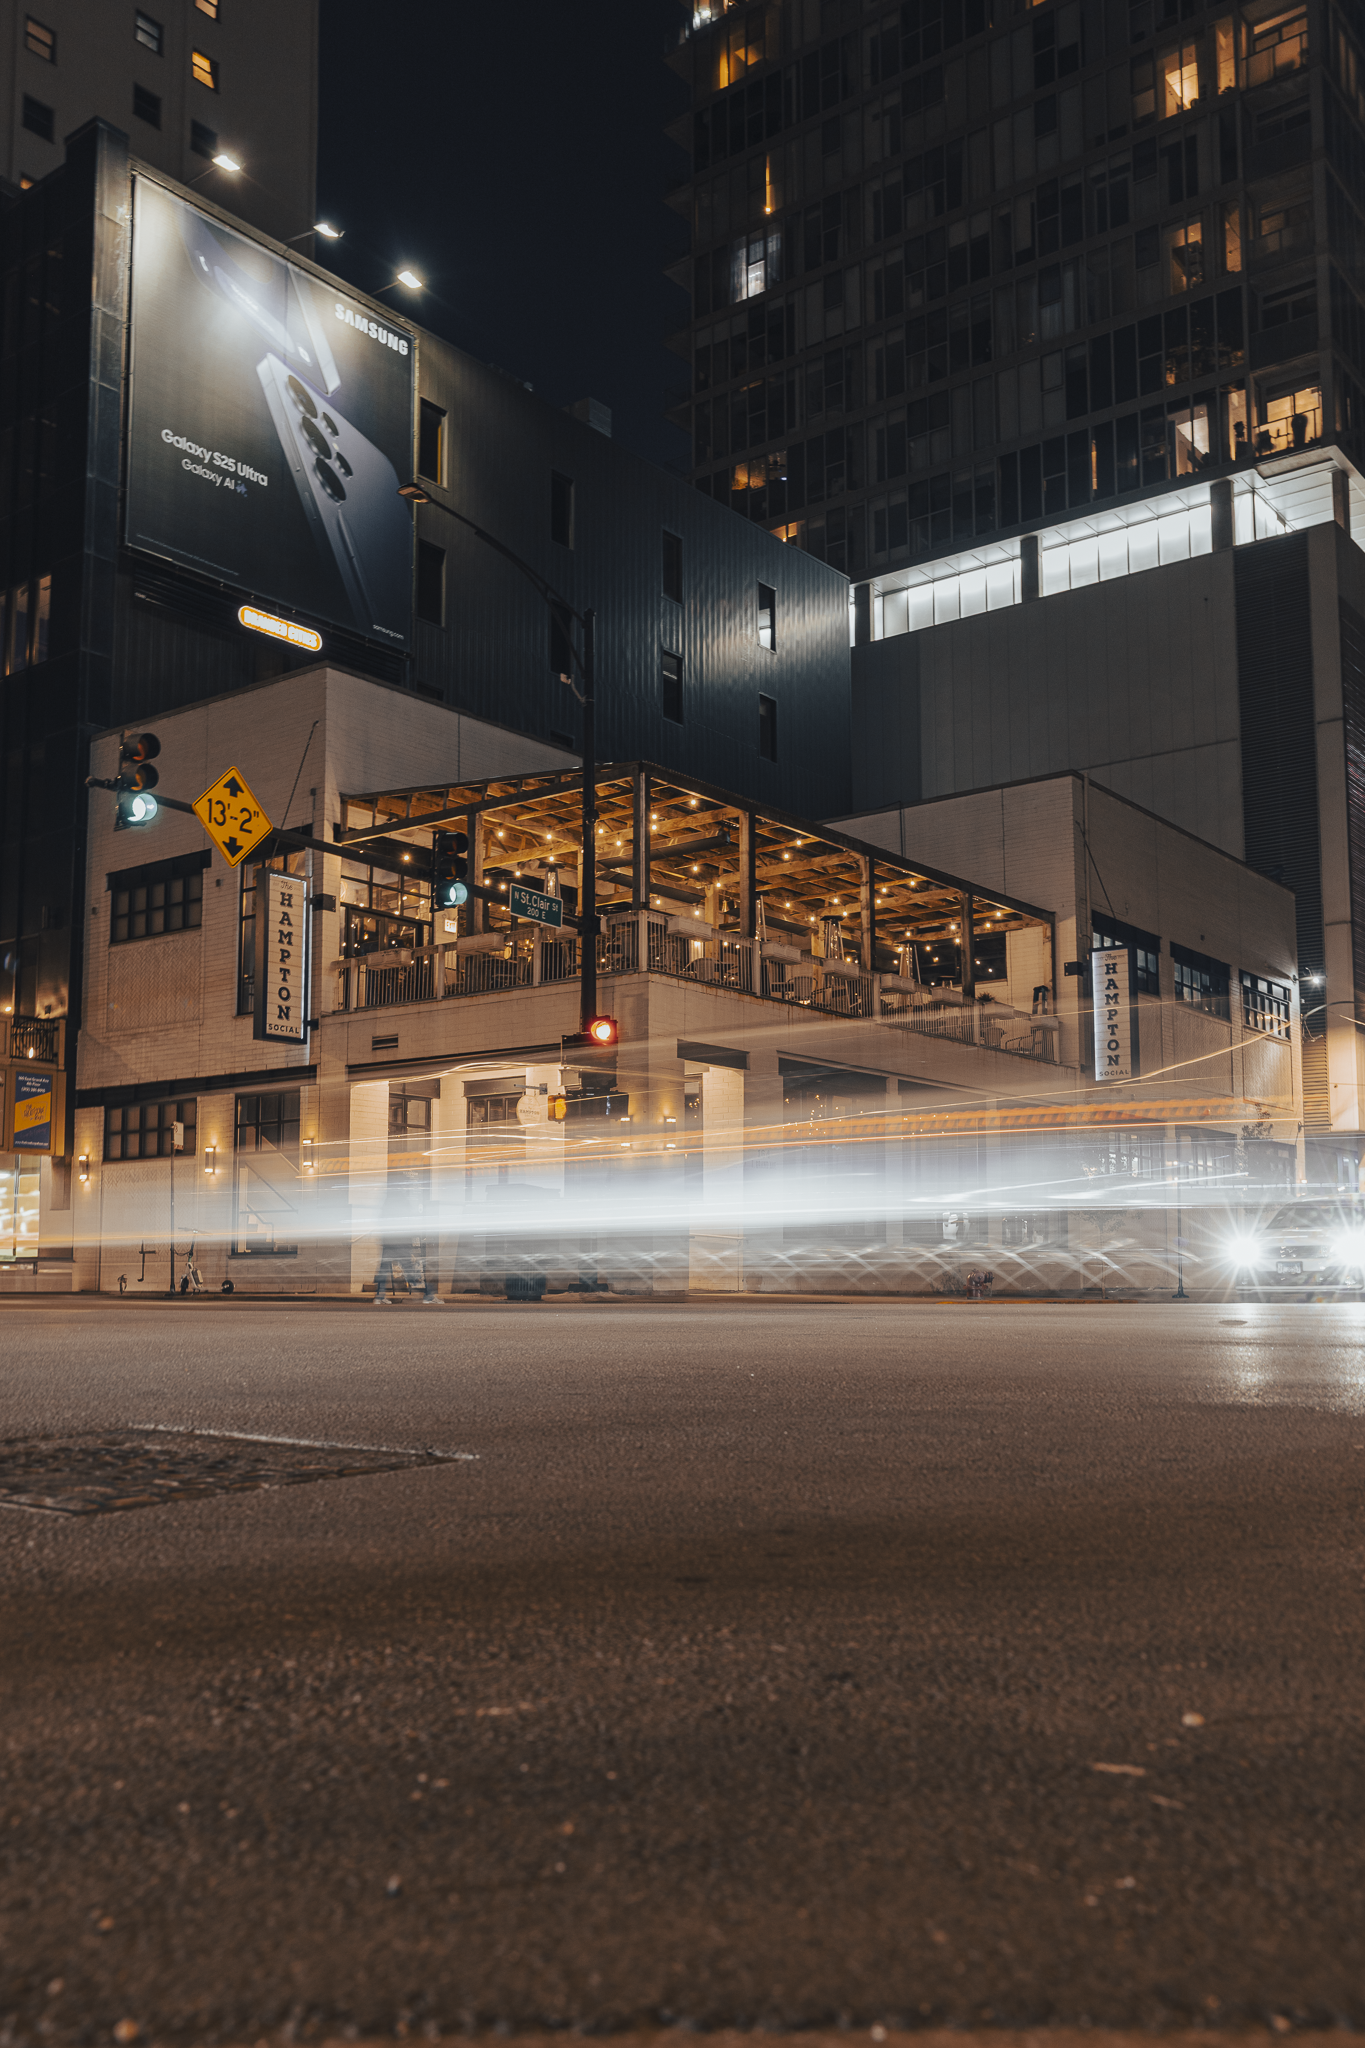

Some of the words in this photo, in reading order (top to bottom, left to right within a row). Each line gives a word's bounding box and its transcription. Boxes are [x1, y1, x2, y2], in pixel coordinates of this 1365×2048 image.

[334, 303, 409, 356] SAMSUNG
[161, 429, 212, 464] Galaxy
[212, 452, 236, 472] S25
[236, 462, 269, 487] Ultra
[181, 458, 223, 487] Galaxy
[223, 477, 236, 490] AI
[514, 891, 520, 900] N
[552, 902, 559, 912] St
[527, 906, 540, 917] 200
[541, 910, 546, 920] E
[277, 891, 294, 1021] HAMPTON
[268, 1023, 300, 1034] SOCIAL
[1104, 962, 1120, 1067] HAMPTON
[1099, 1069, 1130, 1077] SOCIAL
